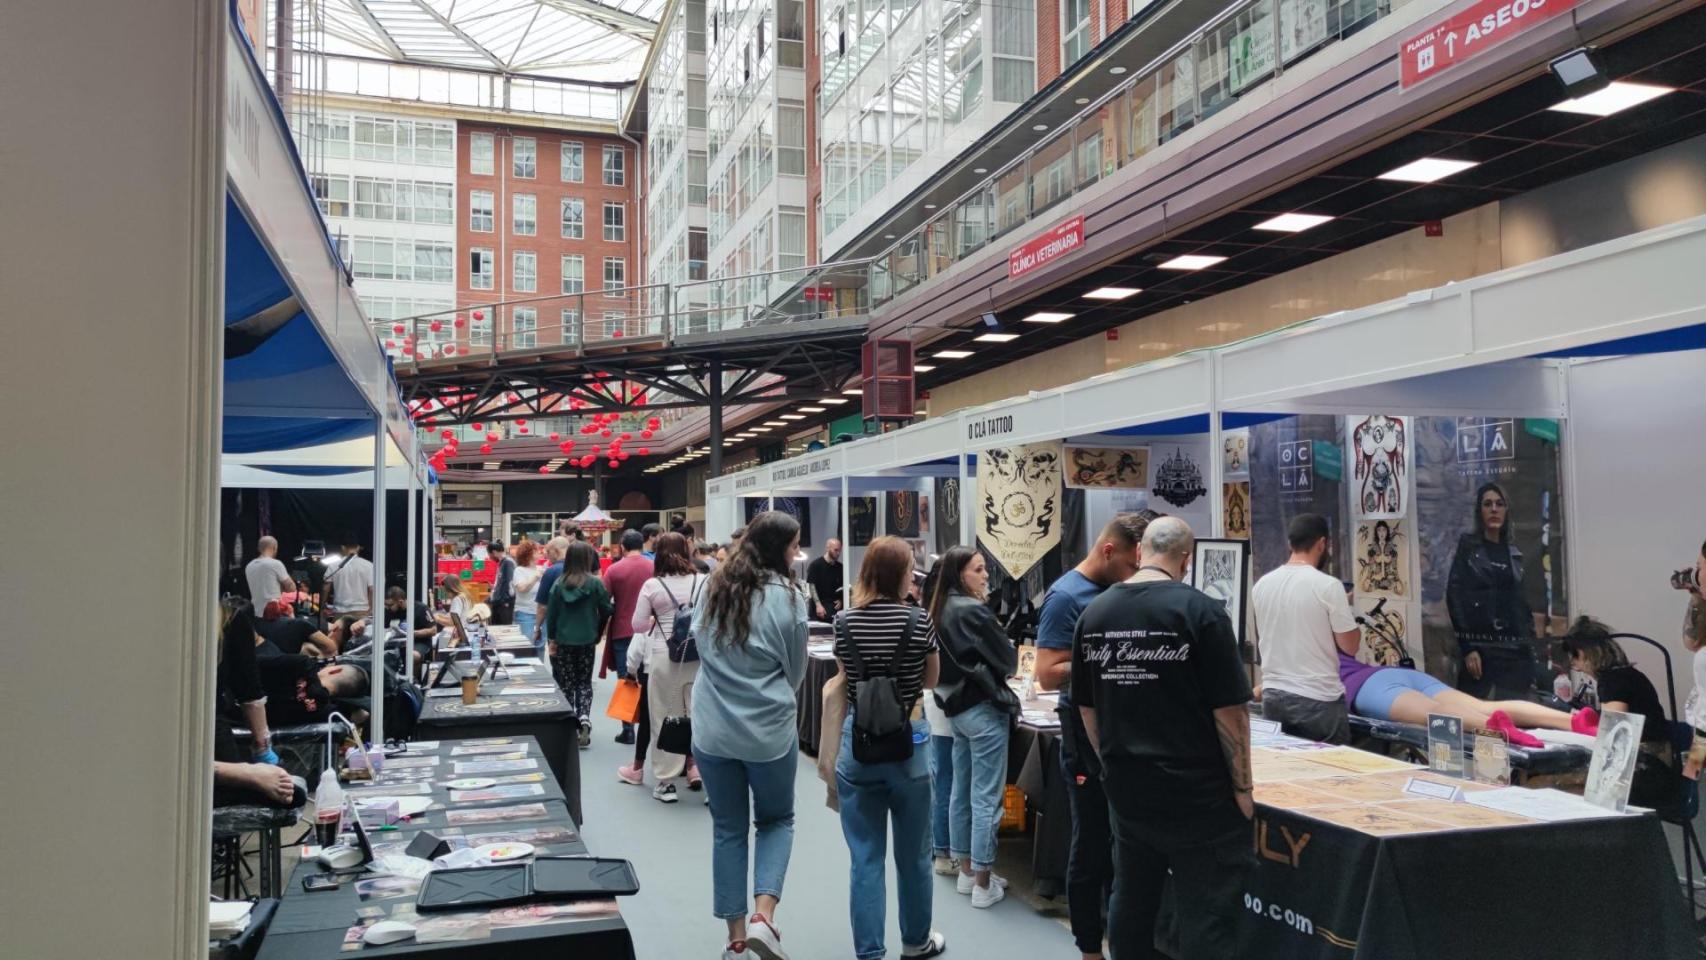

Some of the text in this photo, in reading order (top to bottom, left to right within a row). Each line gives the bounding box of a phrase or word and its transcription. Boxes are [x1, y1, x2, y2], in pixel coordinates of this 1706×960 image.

[1407, 33, 1435, 53] PLANTA
[1036, 231, 1079, 263] VETERINARIA
[968, 423, 973, 440] O
[988, 415, 1013, 436] TATTOO
[1104, 631, 1131, 639] AUTHENTIC
[1131, 630, 1147, 638] STYLE
[1116, 641, 1190, 662] Essentials
